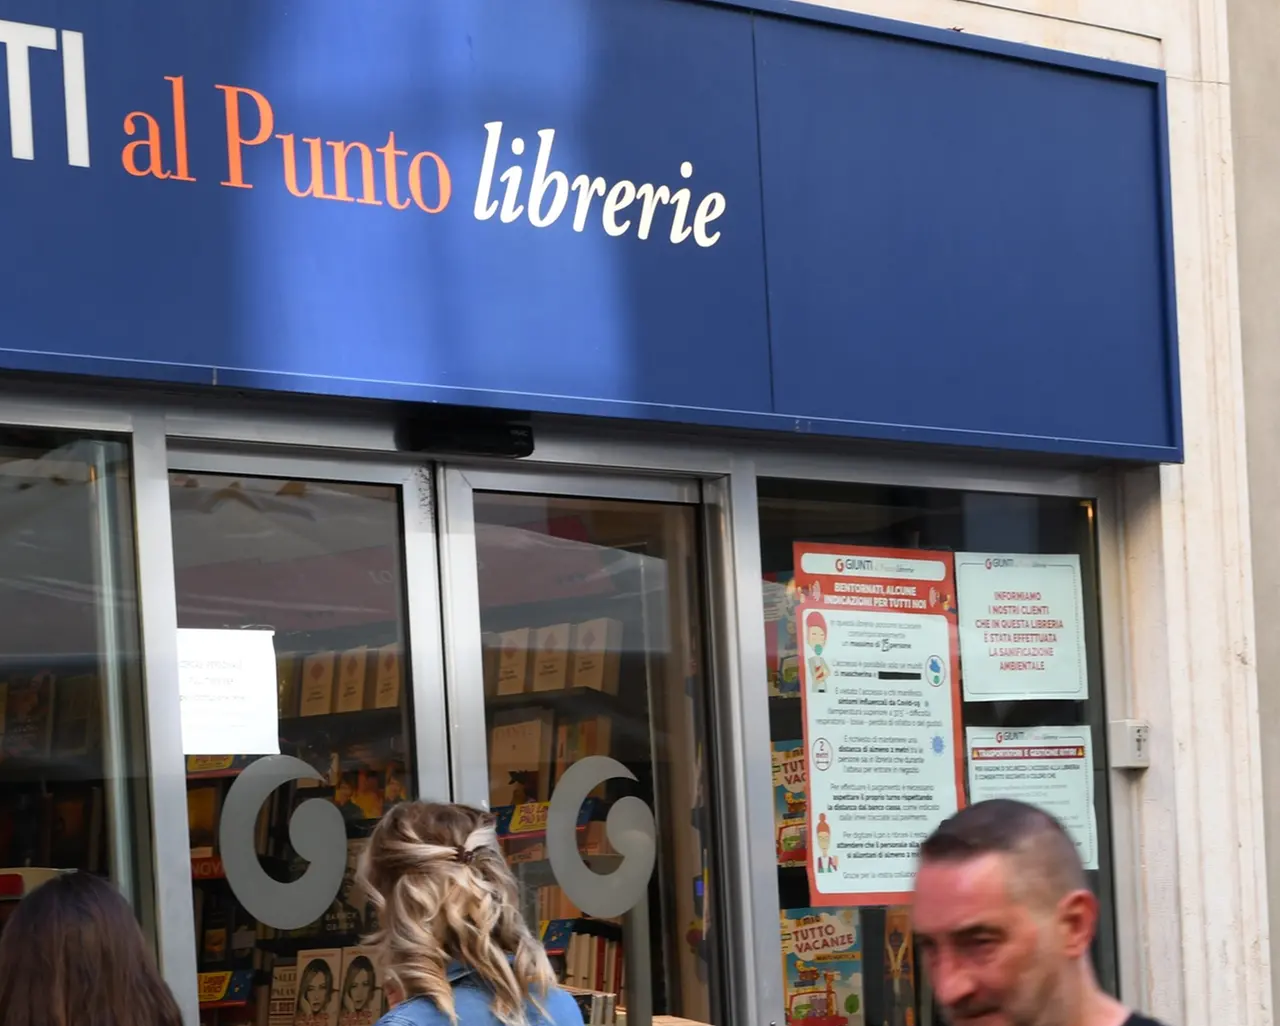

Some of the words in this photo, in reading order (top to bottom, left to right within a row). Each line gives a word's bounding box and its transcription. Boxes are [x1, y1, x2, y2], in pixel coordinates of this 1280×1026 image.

[122, 76, 197, 182] al
[215, 84, 452, 214] Punto
[473, 121, 725, 248] librerie
[846, 559, 873, 571] GIUNTI
[994, 591, 1042, 601] INFORMIAMO
[992, 606, 1019, 614] NOSTRI
[1022, 606, 1049, 615] CLIENTI
[975, 620, 990, 628] CHE
[992, 620, 1000, 628] IN
[1001, 620, 1030, 629] QUESTA
[1031, 620, 1064, 629] LIBRERIA
[989, 634, 1012, 642] STATA
[1013, 634, 1057, 643] EFFETTUATA
[1000, 661, 1045, 671] AMBIENTALE
[792, 925, 835, 943] TUTTO
[794, 934, 854, 953] VACANZE
